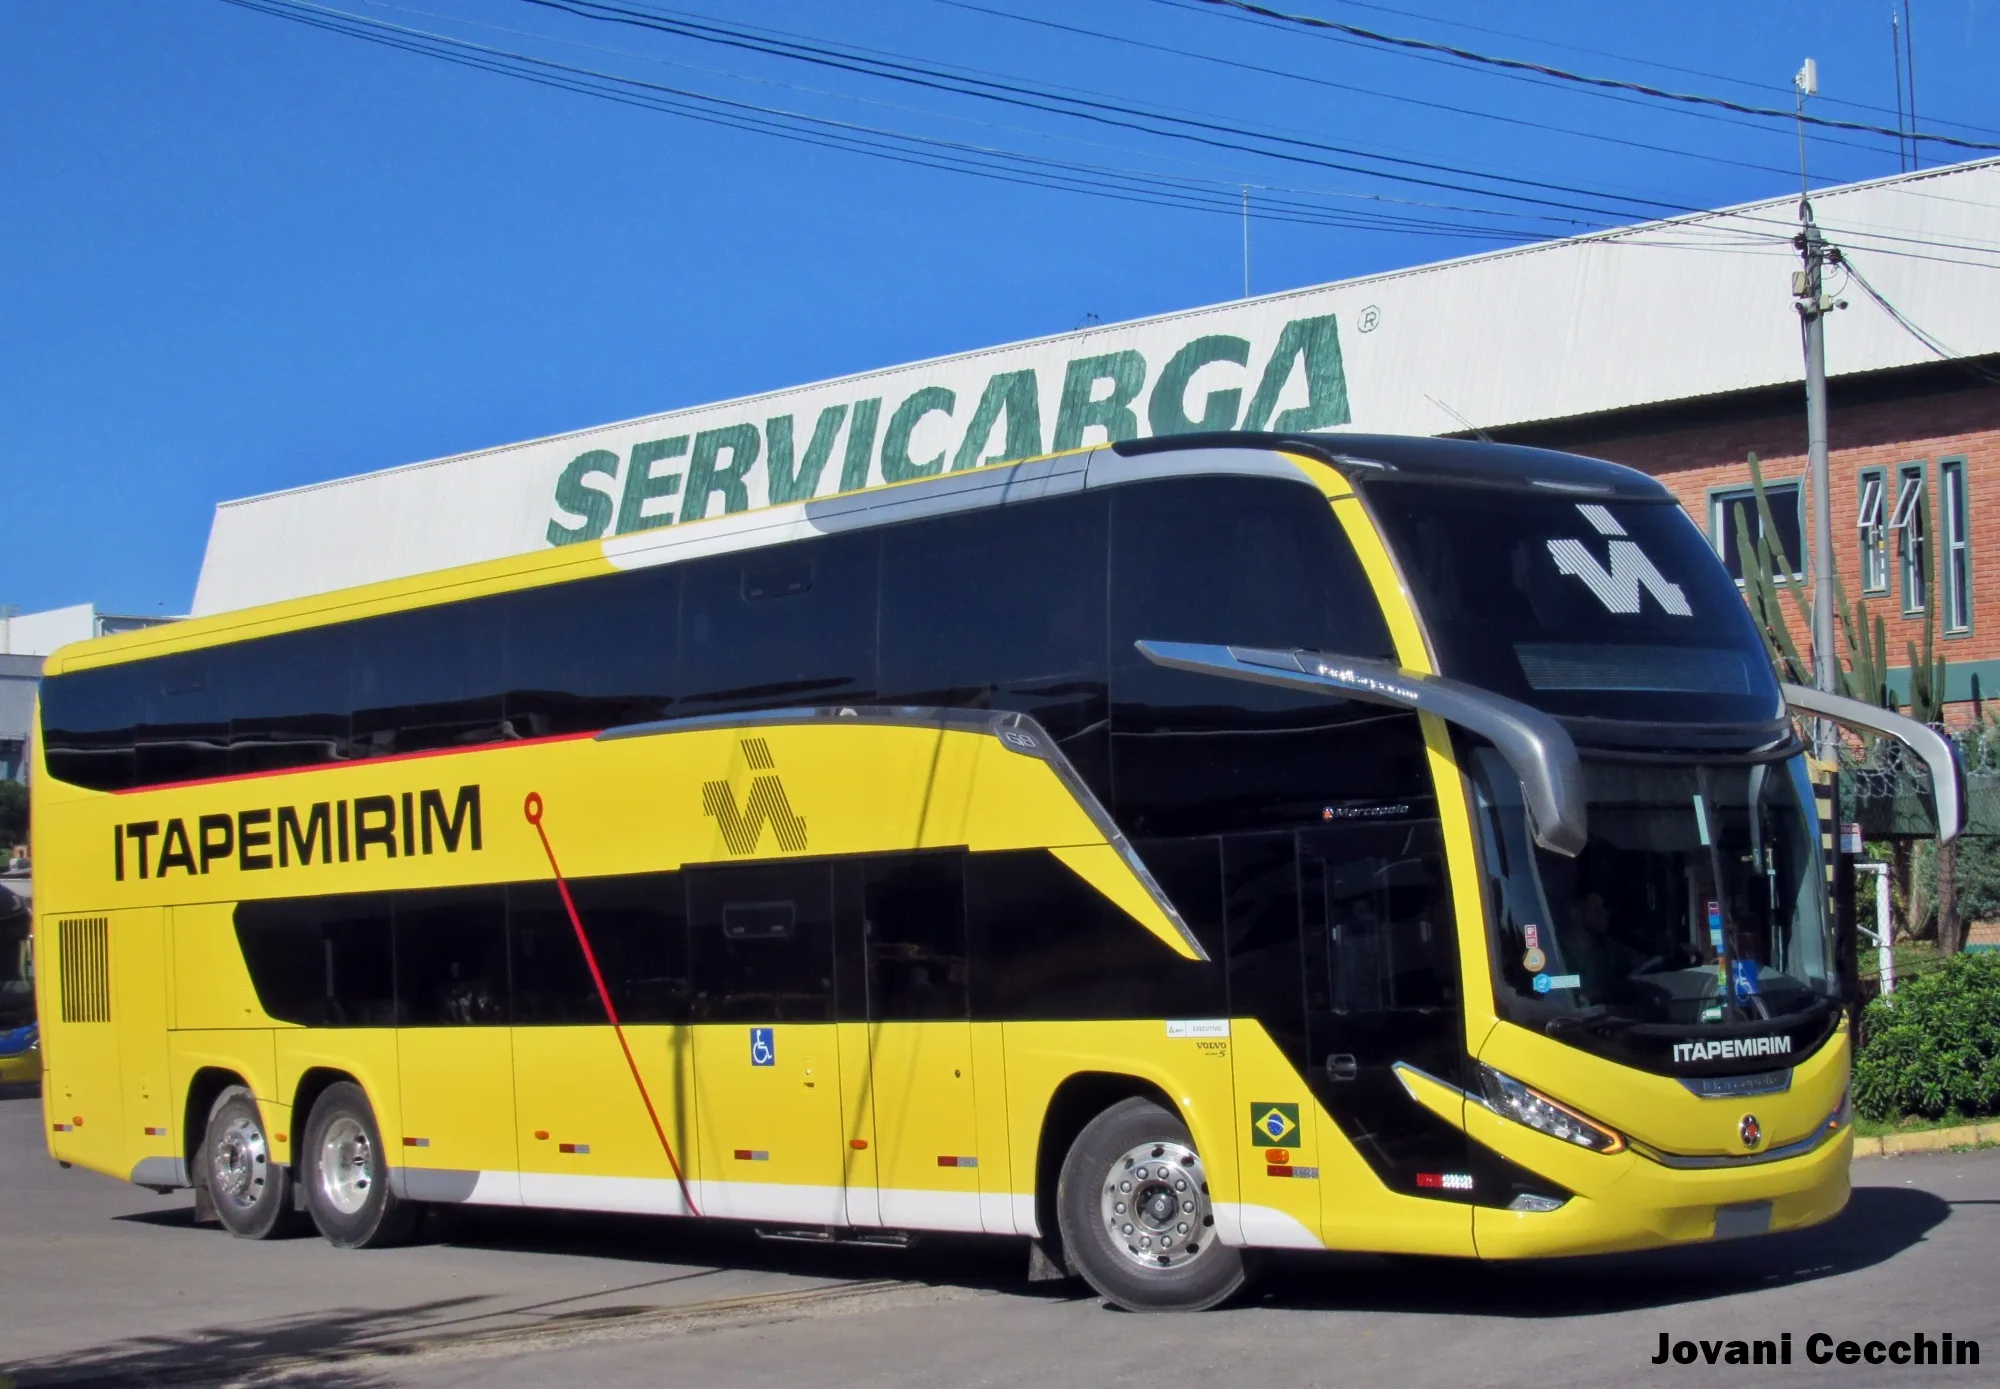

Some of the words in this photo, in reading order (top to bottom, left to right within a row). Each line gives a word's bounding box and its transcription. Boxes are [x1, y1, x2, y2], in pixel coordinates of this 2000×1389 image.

[545, 312, 1352, 547] SERVICARGA
[1335, 804, 1408, 817] Marcopolo
[114, 784, 483, 882] ITAPEMIRIM
[1195, 1042, 1227, 1050] VOLVO
[1673, 1035, 1792, 1062] ITAPEMIRIM
